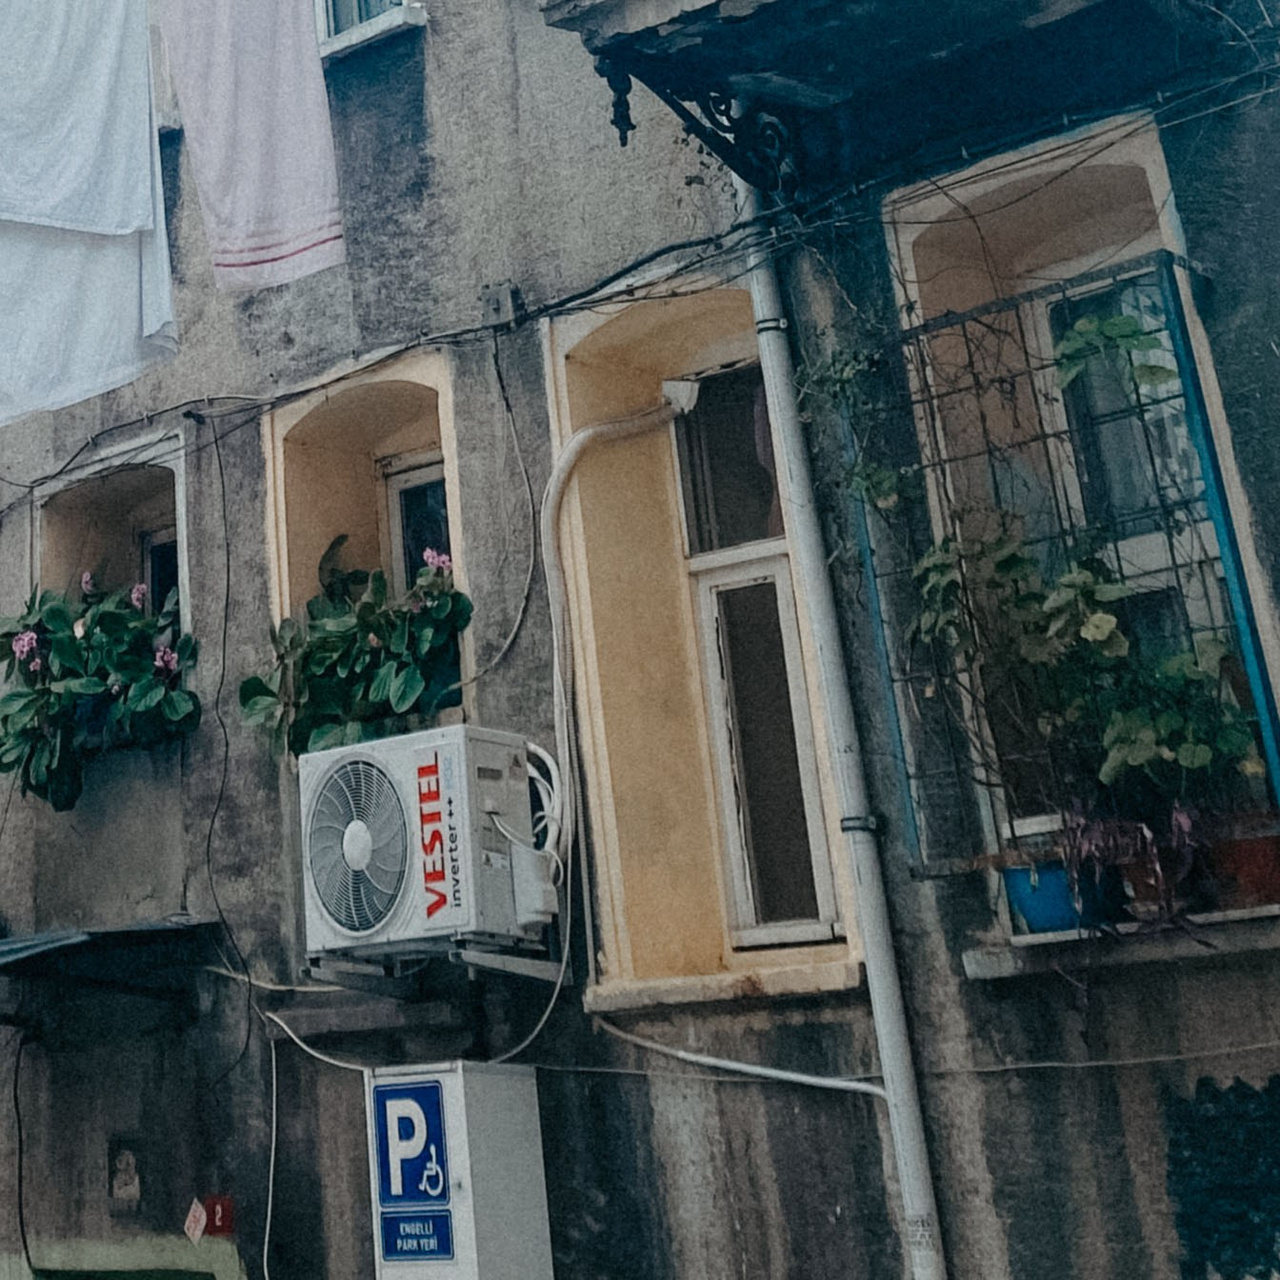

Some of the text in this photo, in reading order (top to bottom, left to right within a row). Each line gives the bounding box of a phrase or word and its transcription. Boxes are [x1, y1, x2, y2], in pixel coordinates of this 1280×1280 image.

[417, 751, 447, 918] VESTEL
[448, 823, 461, 907] inverter
[386, 1098, 427, 1196] P
[215, 1204, 222, 1226] 2
